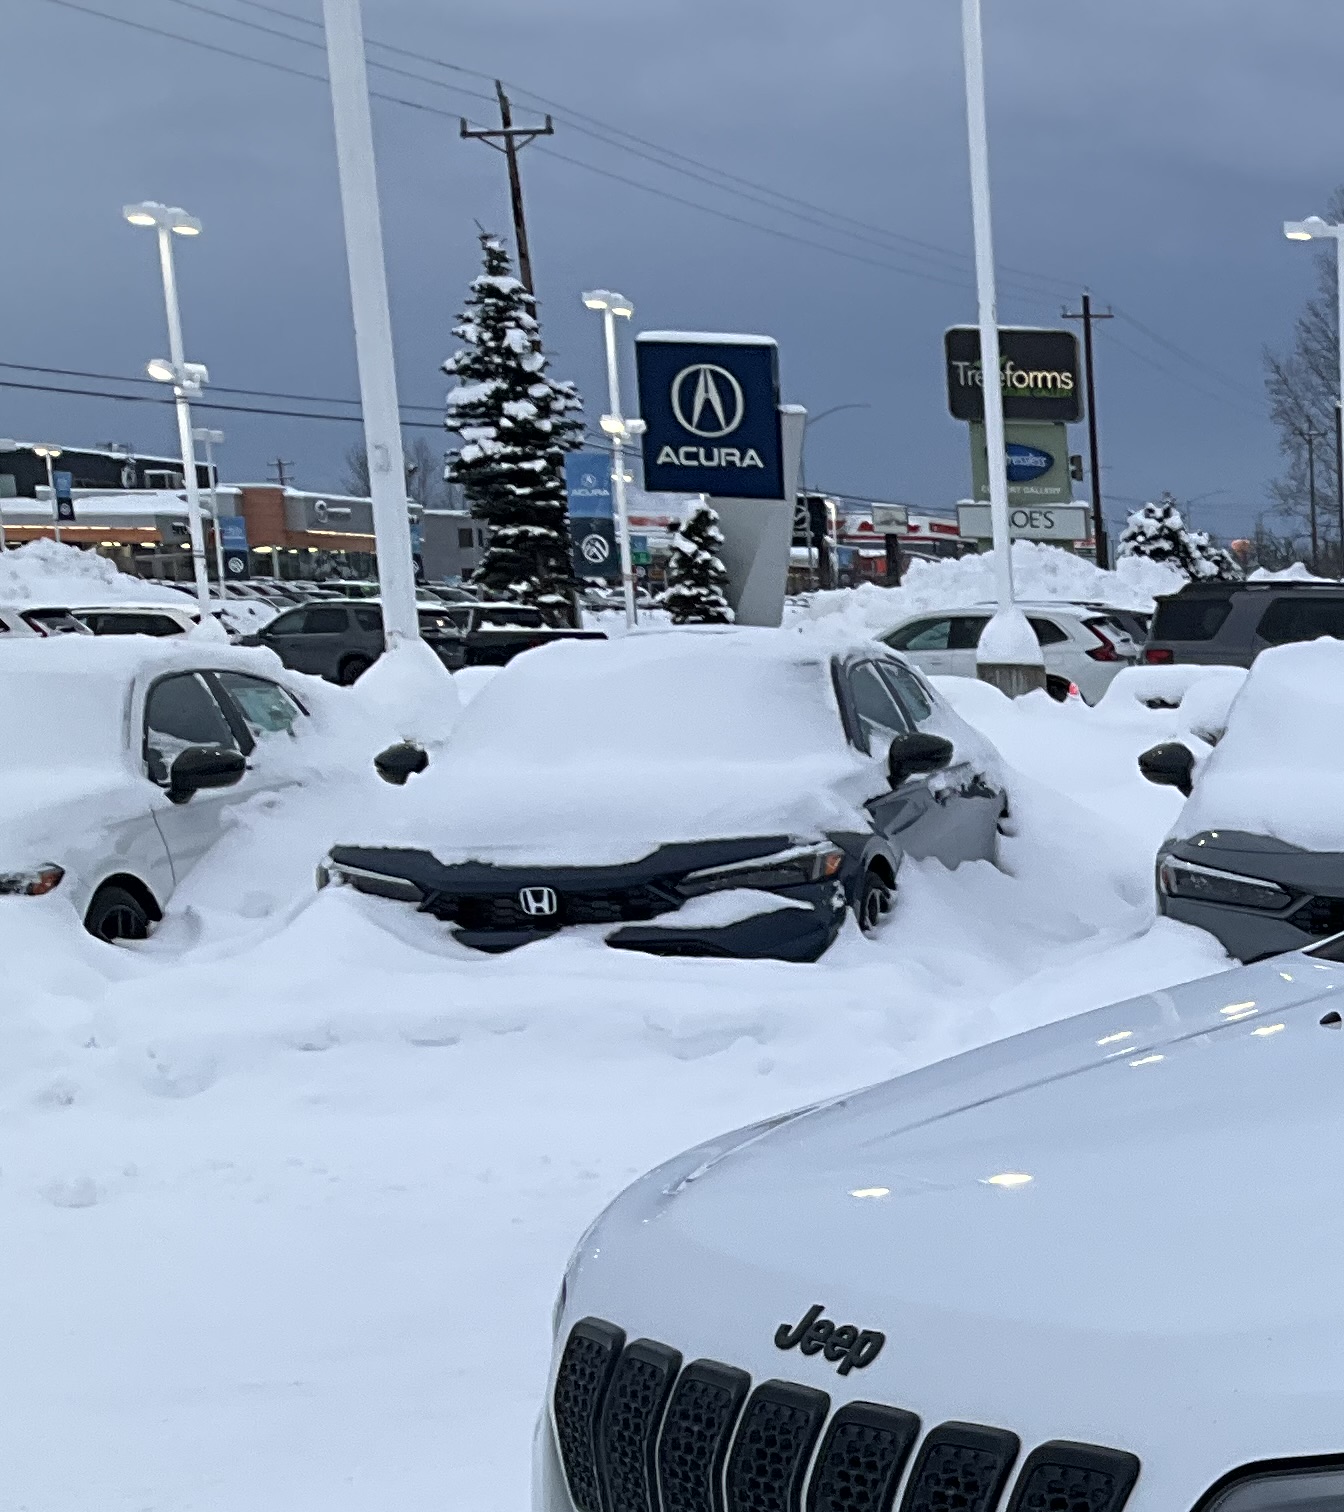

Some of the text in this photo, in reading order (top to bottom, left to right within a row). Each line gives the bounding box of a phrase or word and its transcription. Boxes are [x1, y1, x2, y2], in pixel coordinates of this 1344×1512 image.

[656, 446, 765, 468] ACURA
[1009, 510, 1055, 529] OE'S
[774, 1304, 886, 1377] Jeep
